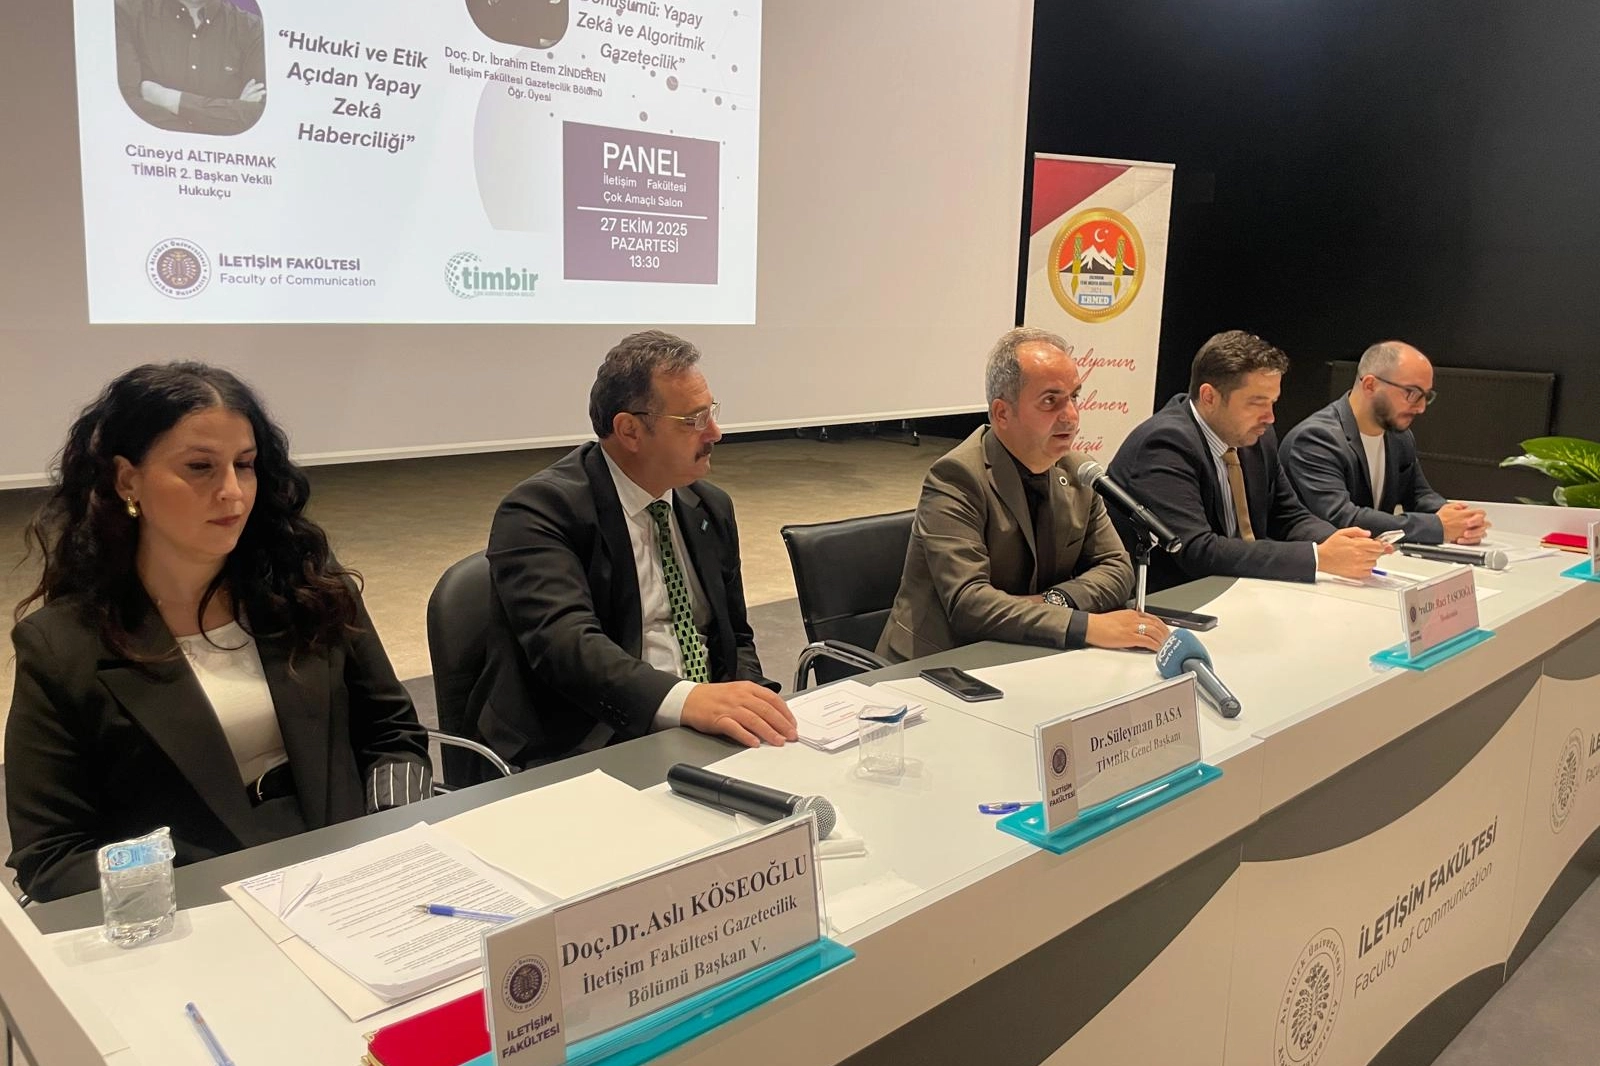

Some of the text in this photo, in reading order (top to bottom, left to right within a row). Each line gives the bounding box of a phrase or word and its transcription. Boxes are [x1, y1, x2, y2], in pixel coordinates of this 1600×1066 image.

[664, 4, 703, 30] Yapay
[576, 11, 706, 52] Zekâ ve Algoritmik
[278, 29, 429, 70] “Hukuki ve Etik
[444, 46, 606, 83] Doç. Dr. İbrahim Etem ZİNDEREN
[286, 61, 422, 99] Açıdan Yapay
[449, 62, 603, 97] İletişim Fakültesi Gazetecilik Bölümü
[507, 85, 552, 102] Öğr. Üyesi
[332, 97, 382, 119] Zekâ
[298, 123, 416, 154] Haberciliği”
[125, 144, 277, 168] Cüneyd ALTIPARMAK
[602, 141, 686, 178] PANEL
[131, 163, 273, 185] TİMBİR 2. Başkan Vekili
[603, 172, 687, 193] İletişim Fakültesi
[178, 185, 231, 199] Hukukçu
[603, 191, 683, 208] Çok Amaçlı Salon
[600, 217, 688, 236] 27 EKİM 2025
[611, 236, 679, 253] PAZARTESİ
[218, 253, 361, 271] İLETİŞİM FAKÜLTESİ
[629, 255, 660, 268] 13:30
[220, 273, 376, 287] Faculty of Communication
[461, 266, 539, 291] timbir
[1081, 295, 1110, 304] ERMED
[1066, 346, 1136, 384] edyanın
[1090, 706, 1183, 753] Dr.Süleyman BASA
[1096, 733, 1181, 774] TİMBİR Genel Başkanı
[1049, 789, 1076, 807] FAKÜLTESİ
[1051, 783, 1072, 797] İLETİŞİM
[1358, 814, 1499, 959] İLETİŞİM FAKÜLTESİ
[561, 902, 685, 968] Doç.Dr.Aslı
[691, 853, 809, 917] KÖSEOĞLU
[582, 962, 645, 995] İletişim
[649, 925, 719, 969] Fakültesi
[722, 893, 797, 936] Gazetecilik
[1354, 861, 1493, 999] Faculty of Communication
[628, 937, 767, 1009] Bölümü Başkan V.
[506, 1012, 554, 1043] İLETİŞİM
[501, 1024, 561, 1060] FAKÜLTESİ
